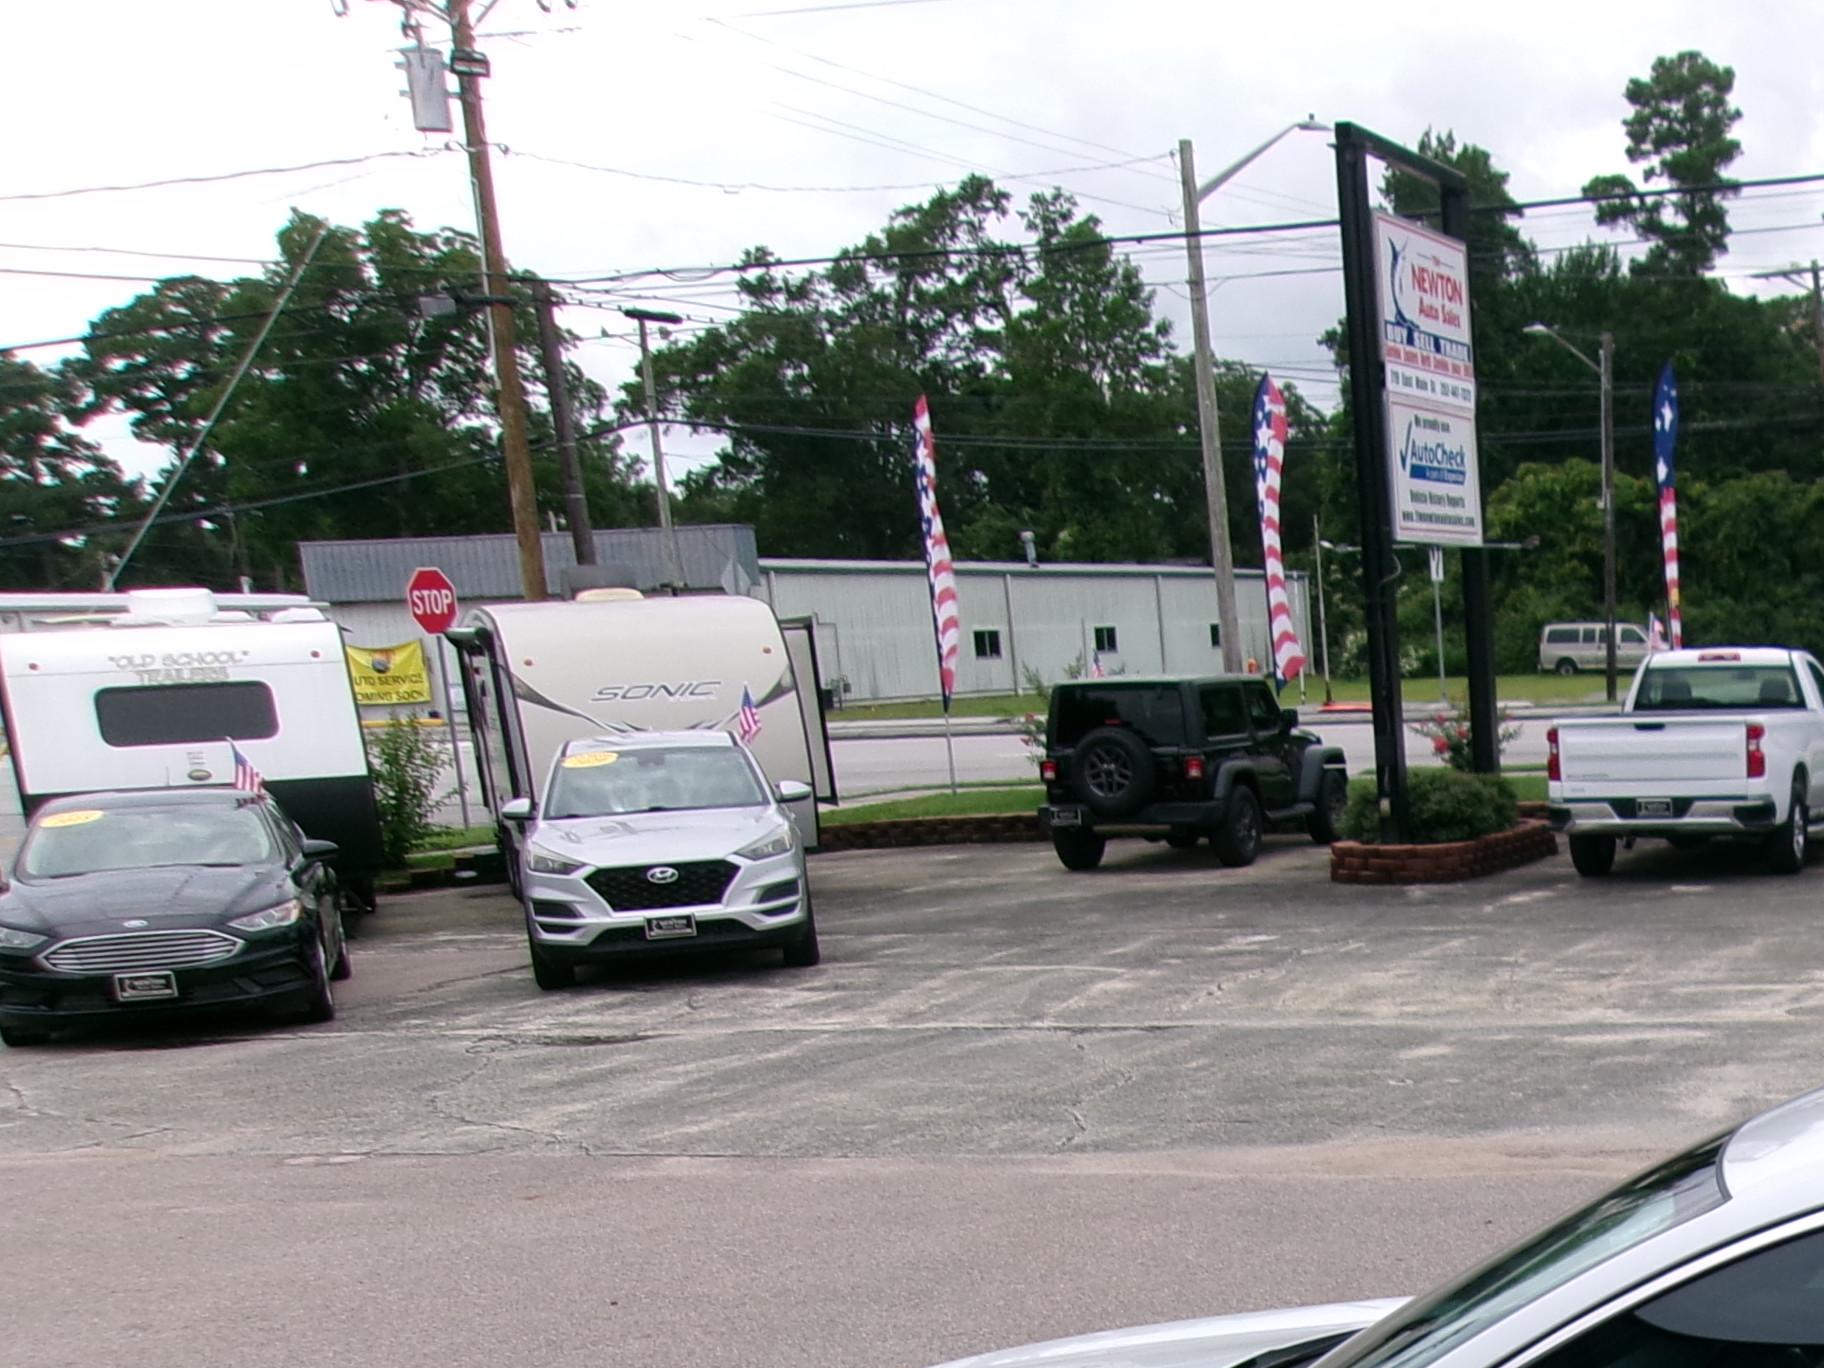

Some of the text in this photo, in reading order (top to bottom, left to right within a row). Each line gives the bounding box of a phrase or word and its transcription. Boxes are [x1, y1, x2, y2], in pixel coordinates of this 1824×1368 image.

[1411, 262, 1463, 306] NEWTON
[1419, 295, 1461, 329] Auto Sales
[1386, 322, 1408, 346] BUY
[1413, 330, 1436, 353] SELL
[1439, 338, 1469, 363] TRADE
[1411, 438, 1466, 469] AutoCheck
[411, 588, 452, 615] STOP
[378, 672, 424, 686] SERVICE
[590, 681, 722, 702] SONIC
